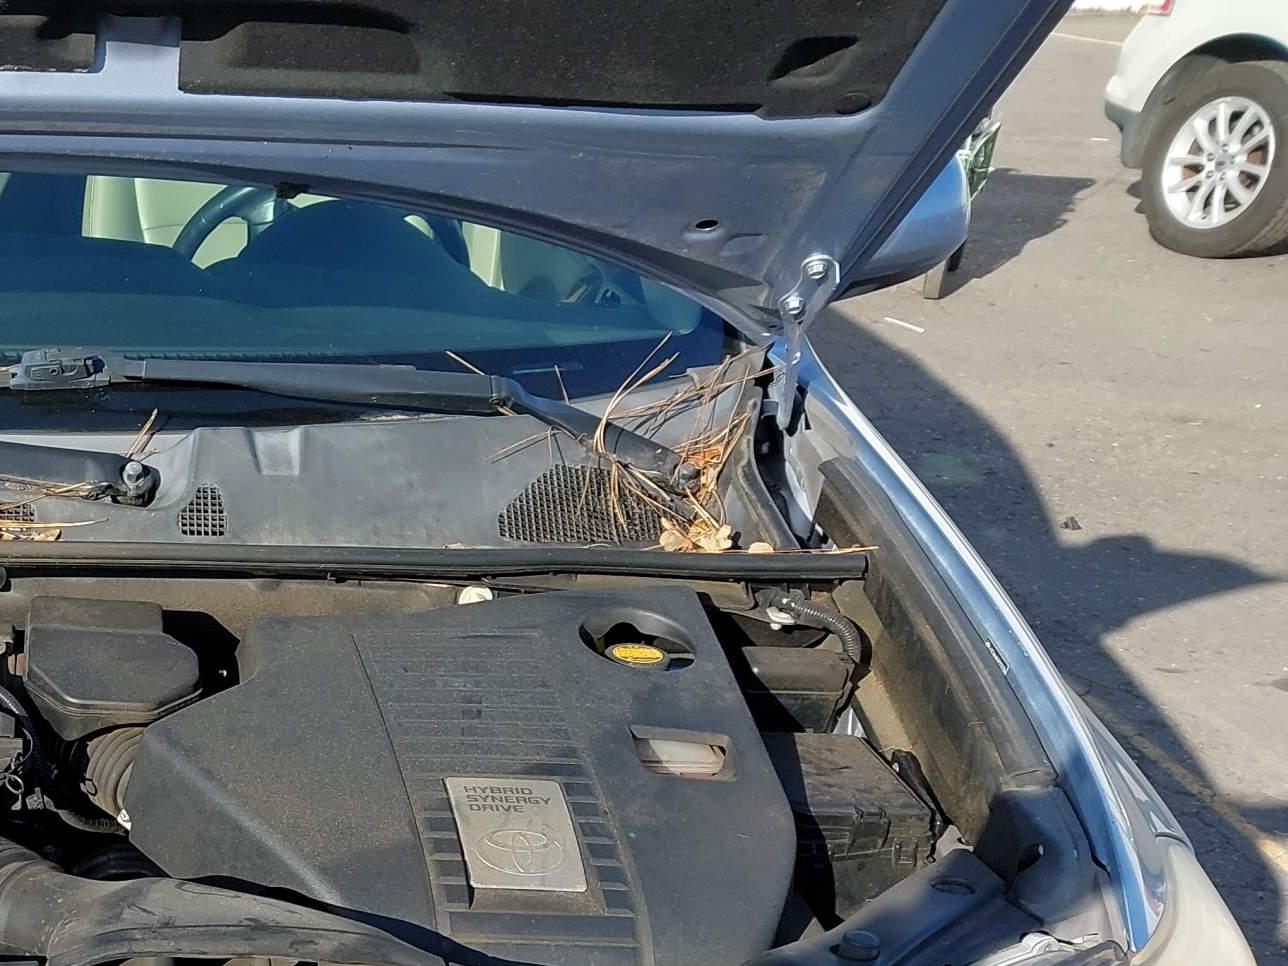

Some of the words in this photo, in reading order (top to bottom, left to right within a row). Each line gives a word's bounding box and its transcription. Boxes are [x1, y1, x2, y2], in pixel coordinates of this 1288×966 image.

[463, 785, 533, 794] HYBRID
[466, 795, 551, 805] SYNERGY
[469, 804, 526, 813] DRIVE
